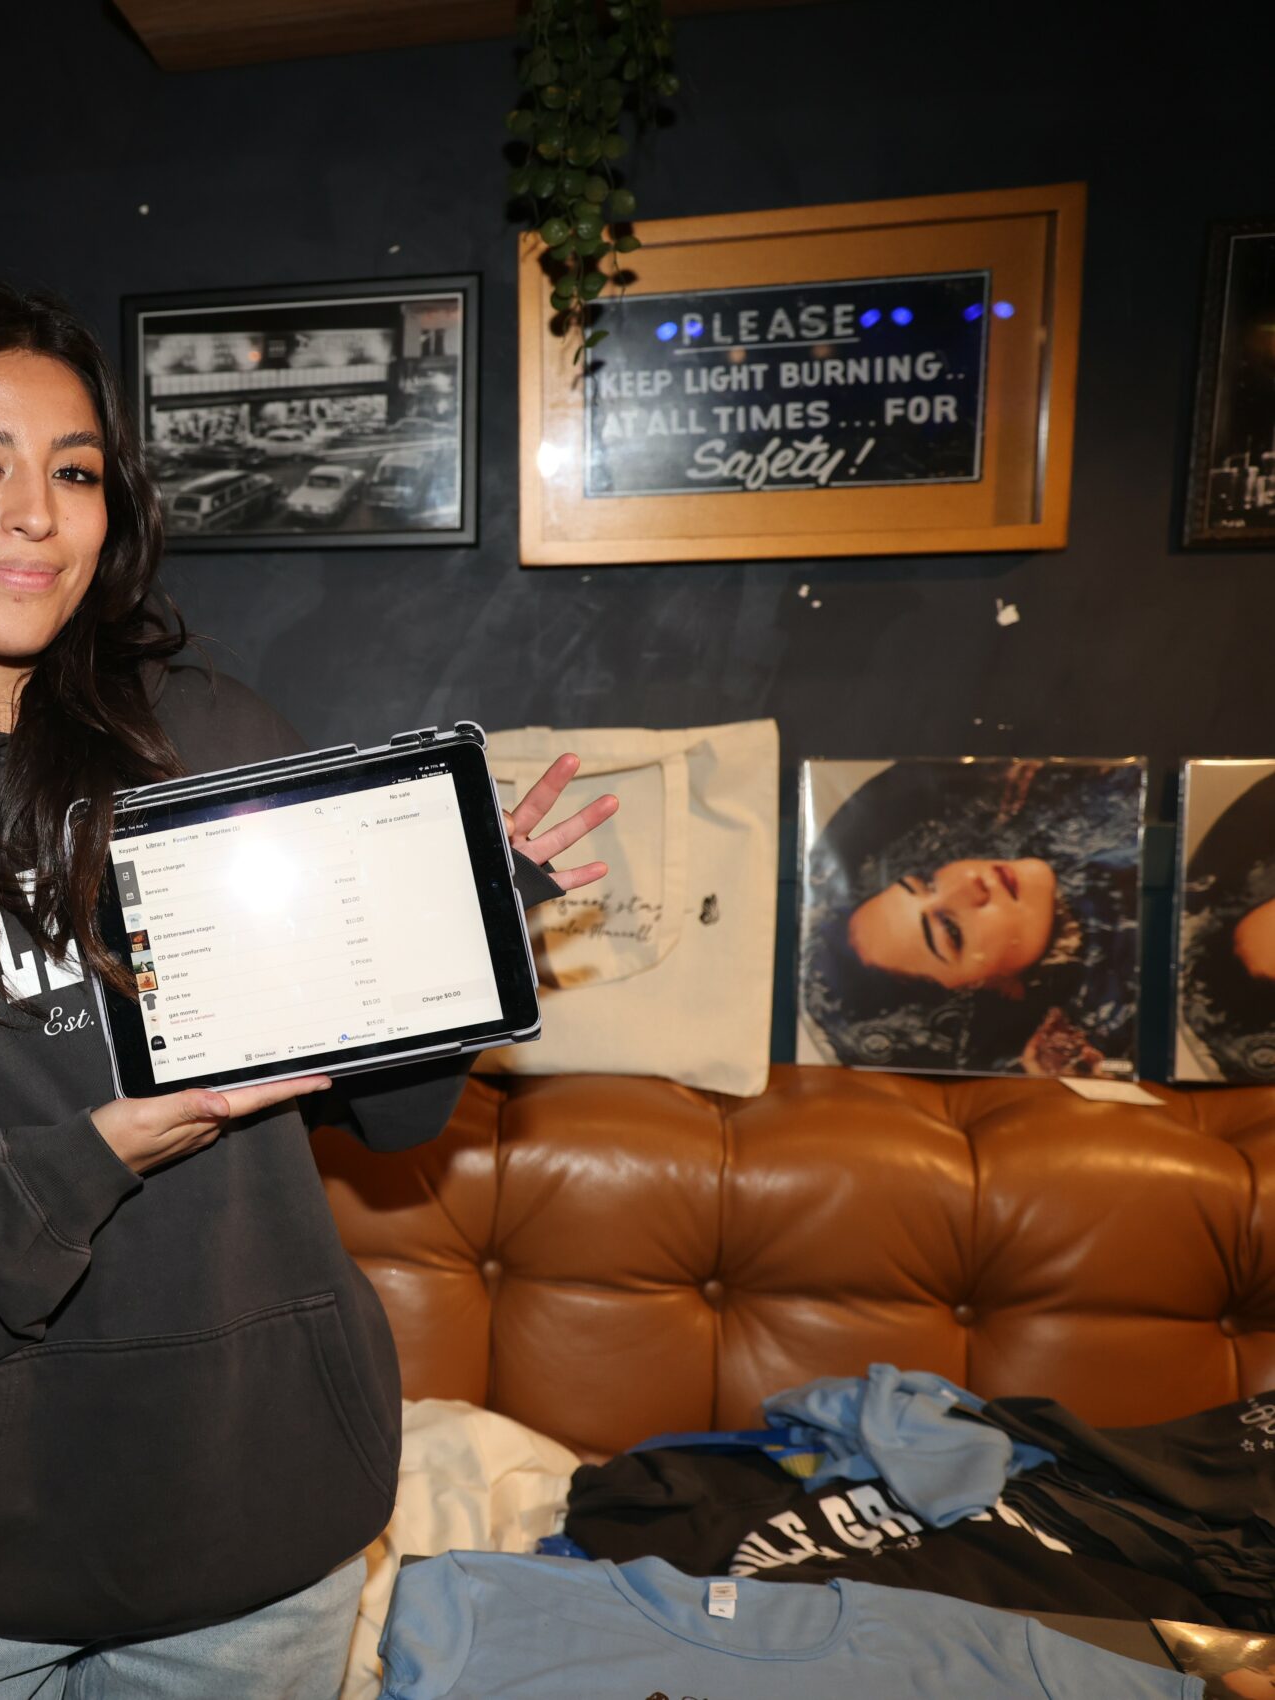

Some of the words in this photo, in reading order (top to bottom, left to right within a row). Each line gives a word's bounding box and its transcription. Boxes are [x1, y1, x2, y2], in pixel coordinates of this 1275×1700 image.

[681, 304, 855, 345] PLEASE
[598, 369, 673, 399] KEEP
[684, 363, 769, 394] LIGHT
[601, 410, 639, 440] AT
[646, 408, 707, 436] ALL
[884, 394, 958, 426] FOR
[376, 817, 388, 825] Add
[393, 812, 420, 822] customer
[118, 846, 139, 854] Keypad
[145, 841, 166, 850] Library
[141, 866, 162, 876] Service
[163, 862, 186, 872] charges
[145, 886, 169, 896] Services
[149, 912, 163, 921] baby
[163, 929, 196, 939] bittersweet
[196, 925, 216, 933] stages
[167, 952, 180, 960] dear
[181, 947, 212, 957] conformity
[165, 993, 180, 1002] clock
[422, 994, 444, 1004] Charge
[444, 990, 461, 999] $0.00
[179, 1008, 199, 1016] money
[44, 1006, 95, 1036] Est.
[183, 1032, 203, 1040] BLACK
[187, 1052, 206, 1060] WHITE
